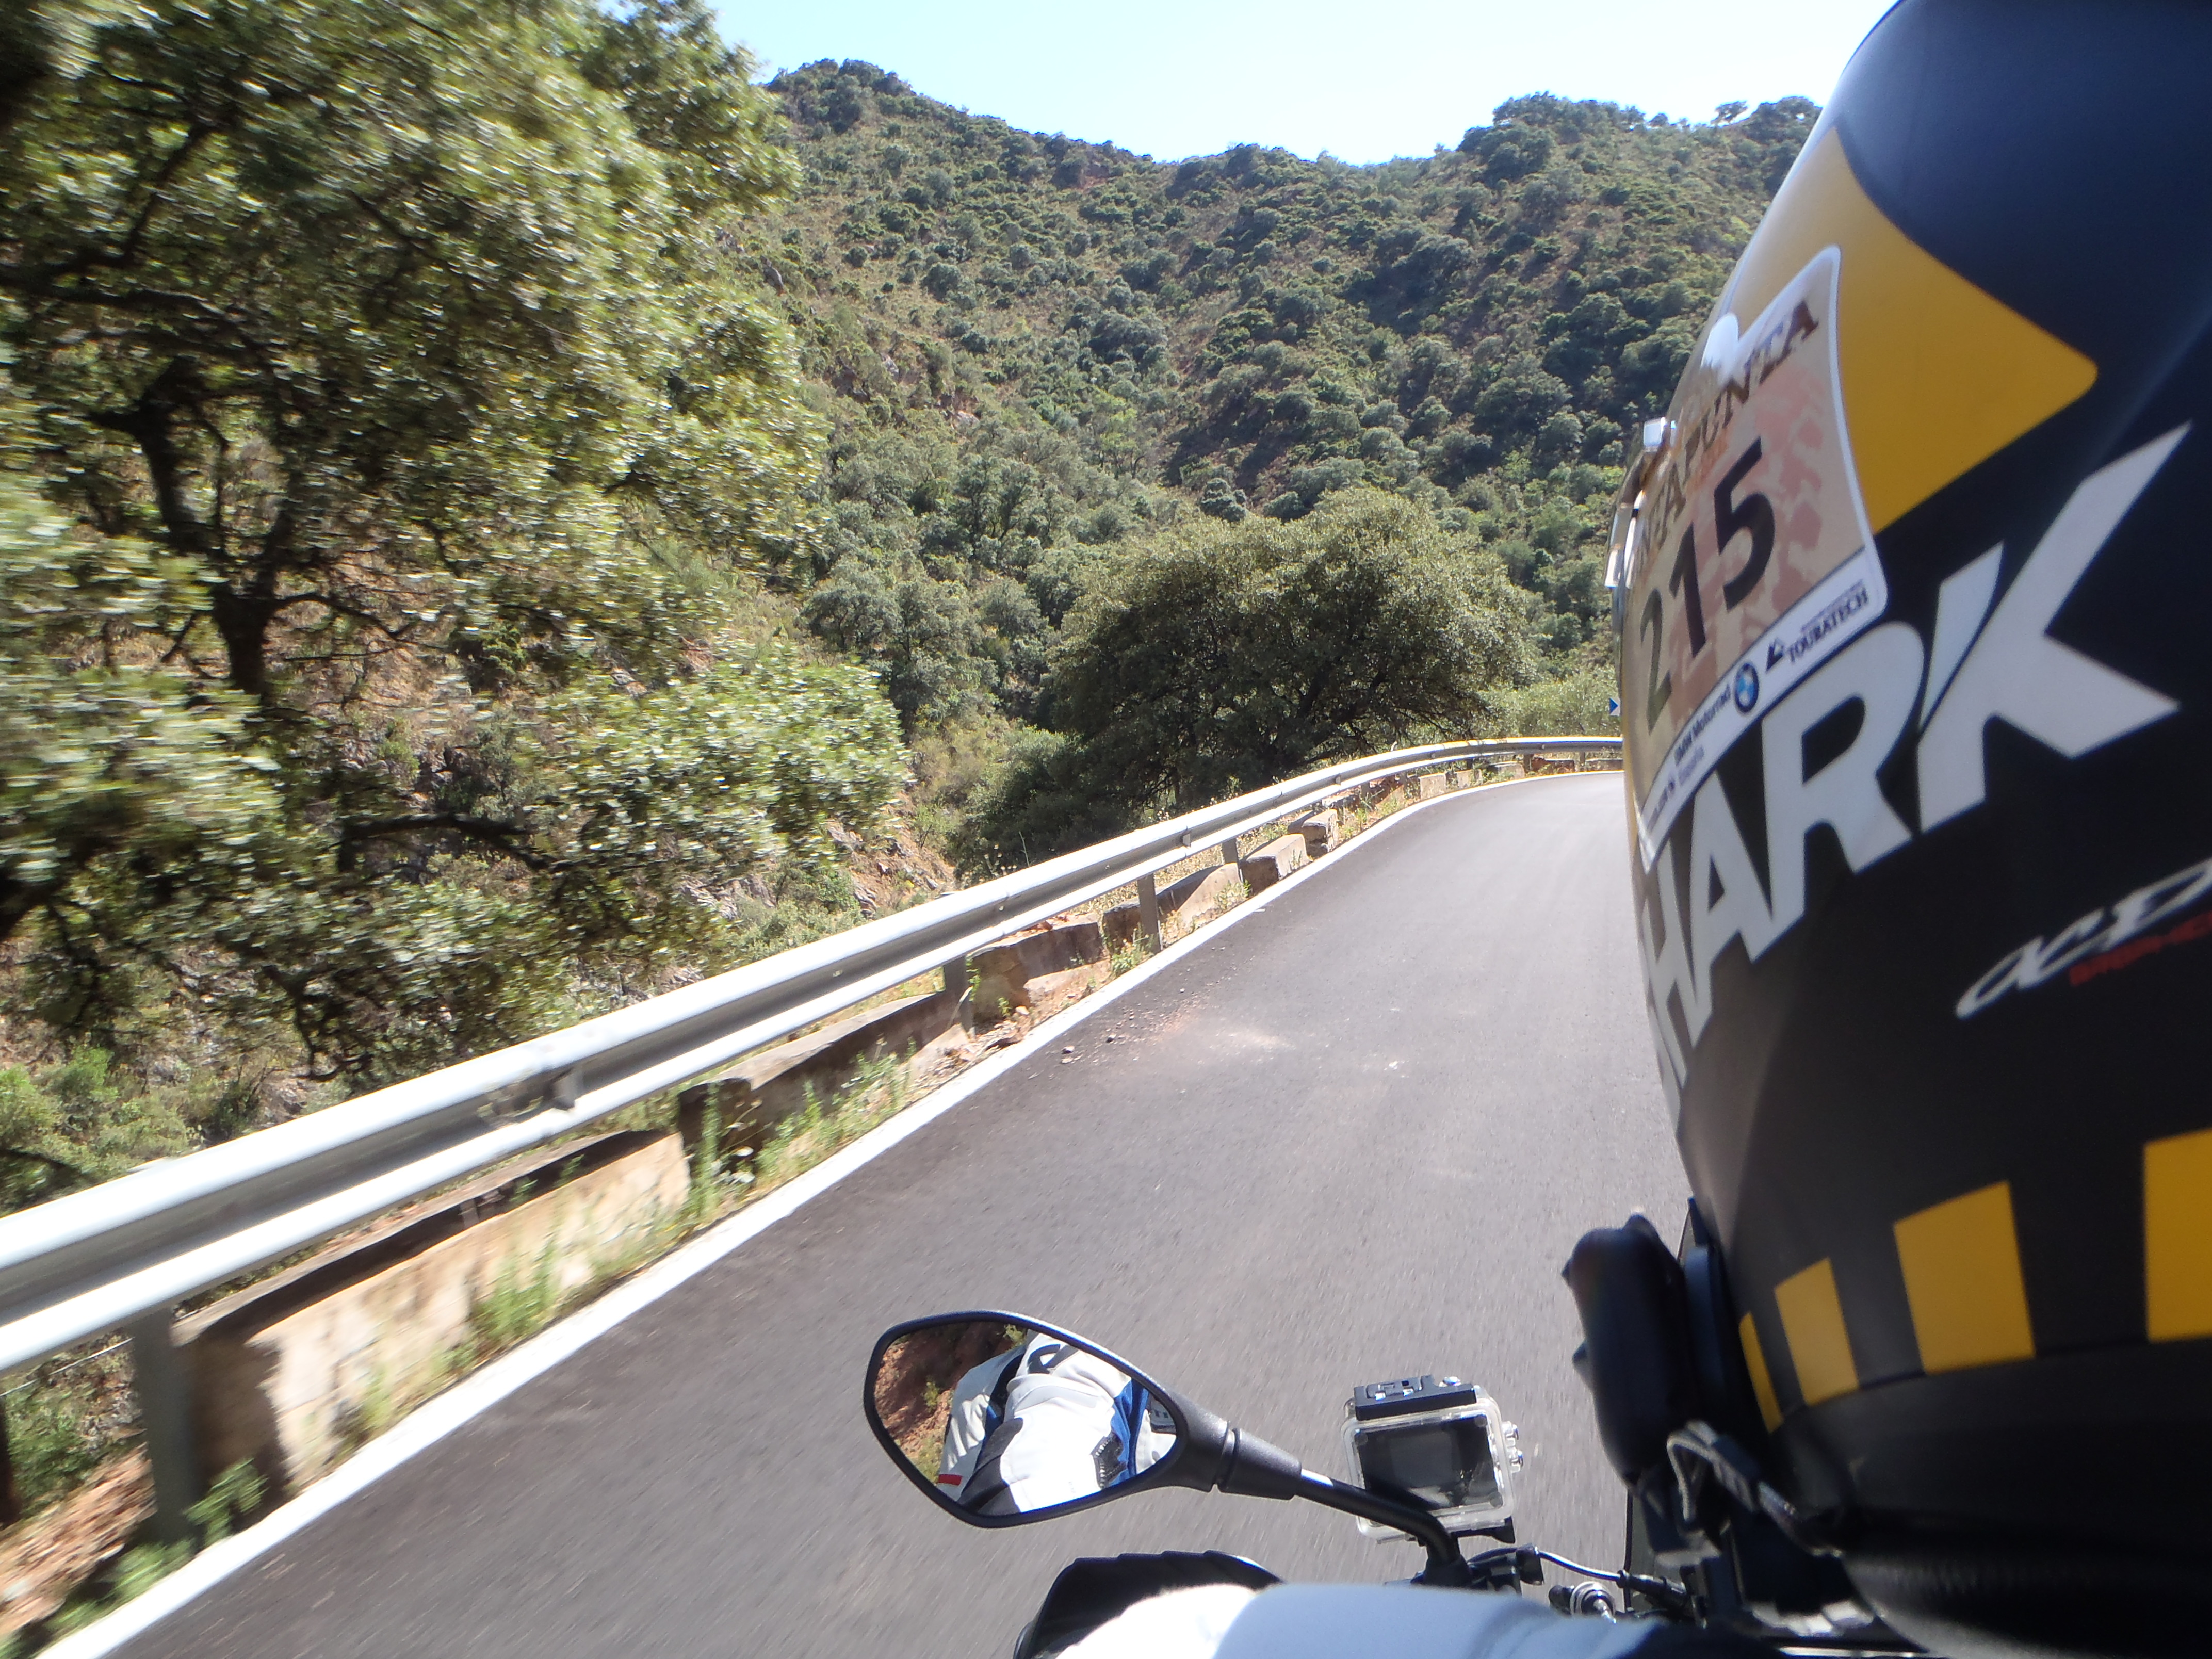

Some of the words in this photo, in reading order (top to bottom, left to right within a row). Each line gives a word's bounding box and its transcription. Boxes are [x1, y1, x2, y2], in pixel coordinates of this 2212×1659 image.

[1640, 436, 1775, 735] 215
[1787, 587, 1869, 662] TOURATECH
[1637, 421, 2192, 1132] HARK
